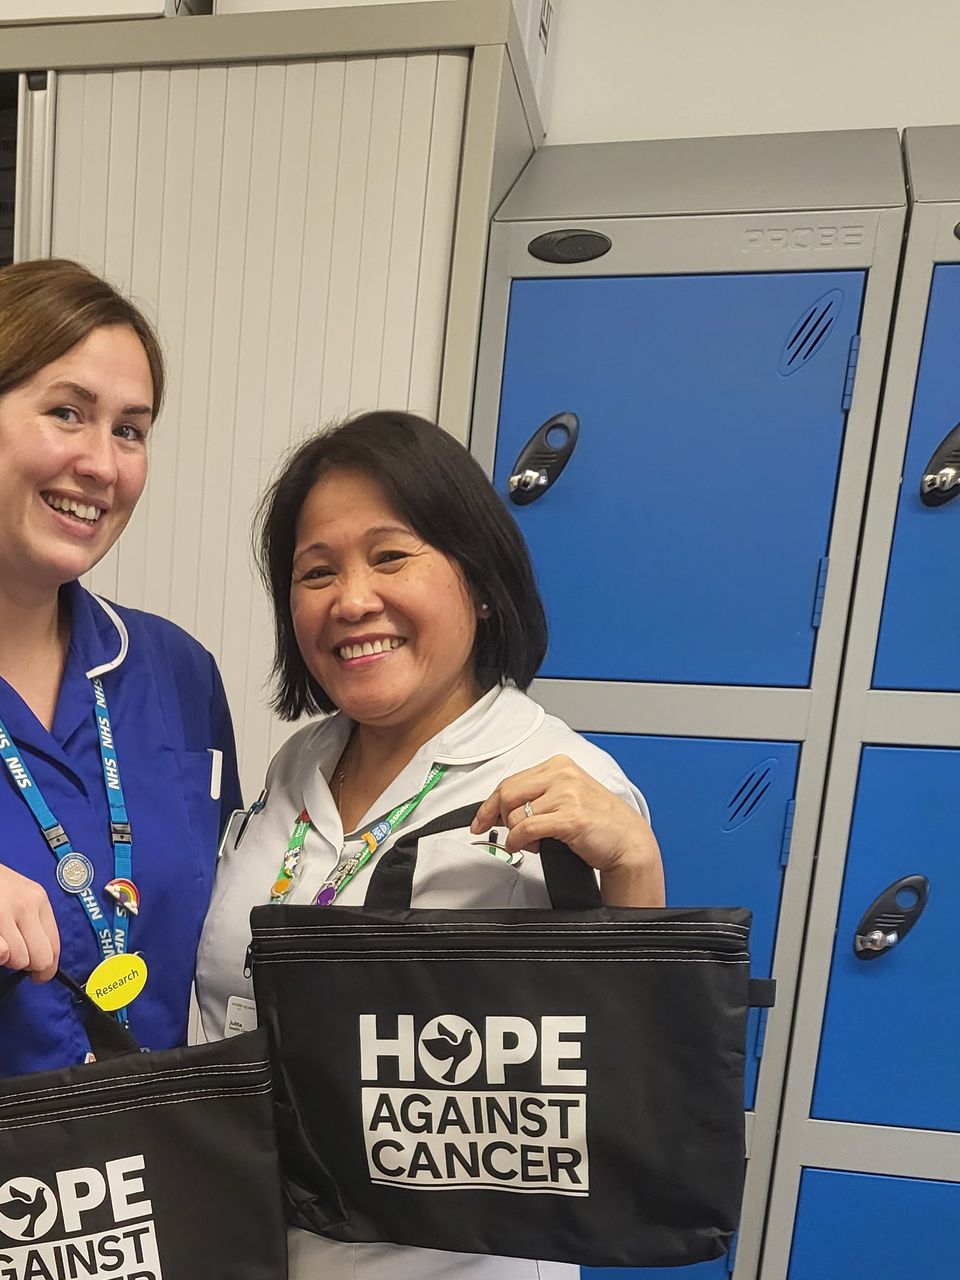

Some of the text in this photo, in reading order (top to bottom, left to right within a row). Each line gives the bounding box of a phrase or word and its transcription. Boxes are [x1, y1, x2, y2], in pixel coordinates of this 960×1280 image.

[743, 225, 864, 252] PROBE
[93, 678, 107, 709] NHS
[99, 716, 114, 749] NHS
[6, 756, 32, 789] NHS
[105, 757, 120, 790] NHS
[95, 969, 139, 999] Research
[359, 1014, 587, 1086] HOPE
[368, 1093, 580, 1139] AGAINST
[371, 1139, 583, 1185] CANCER
